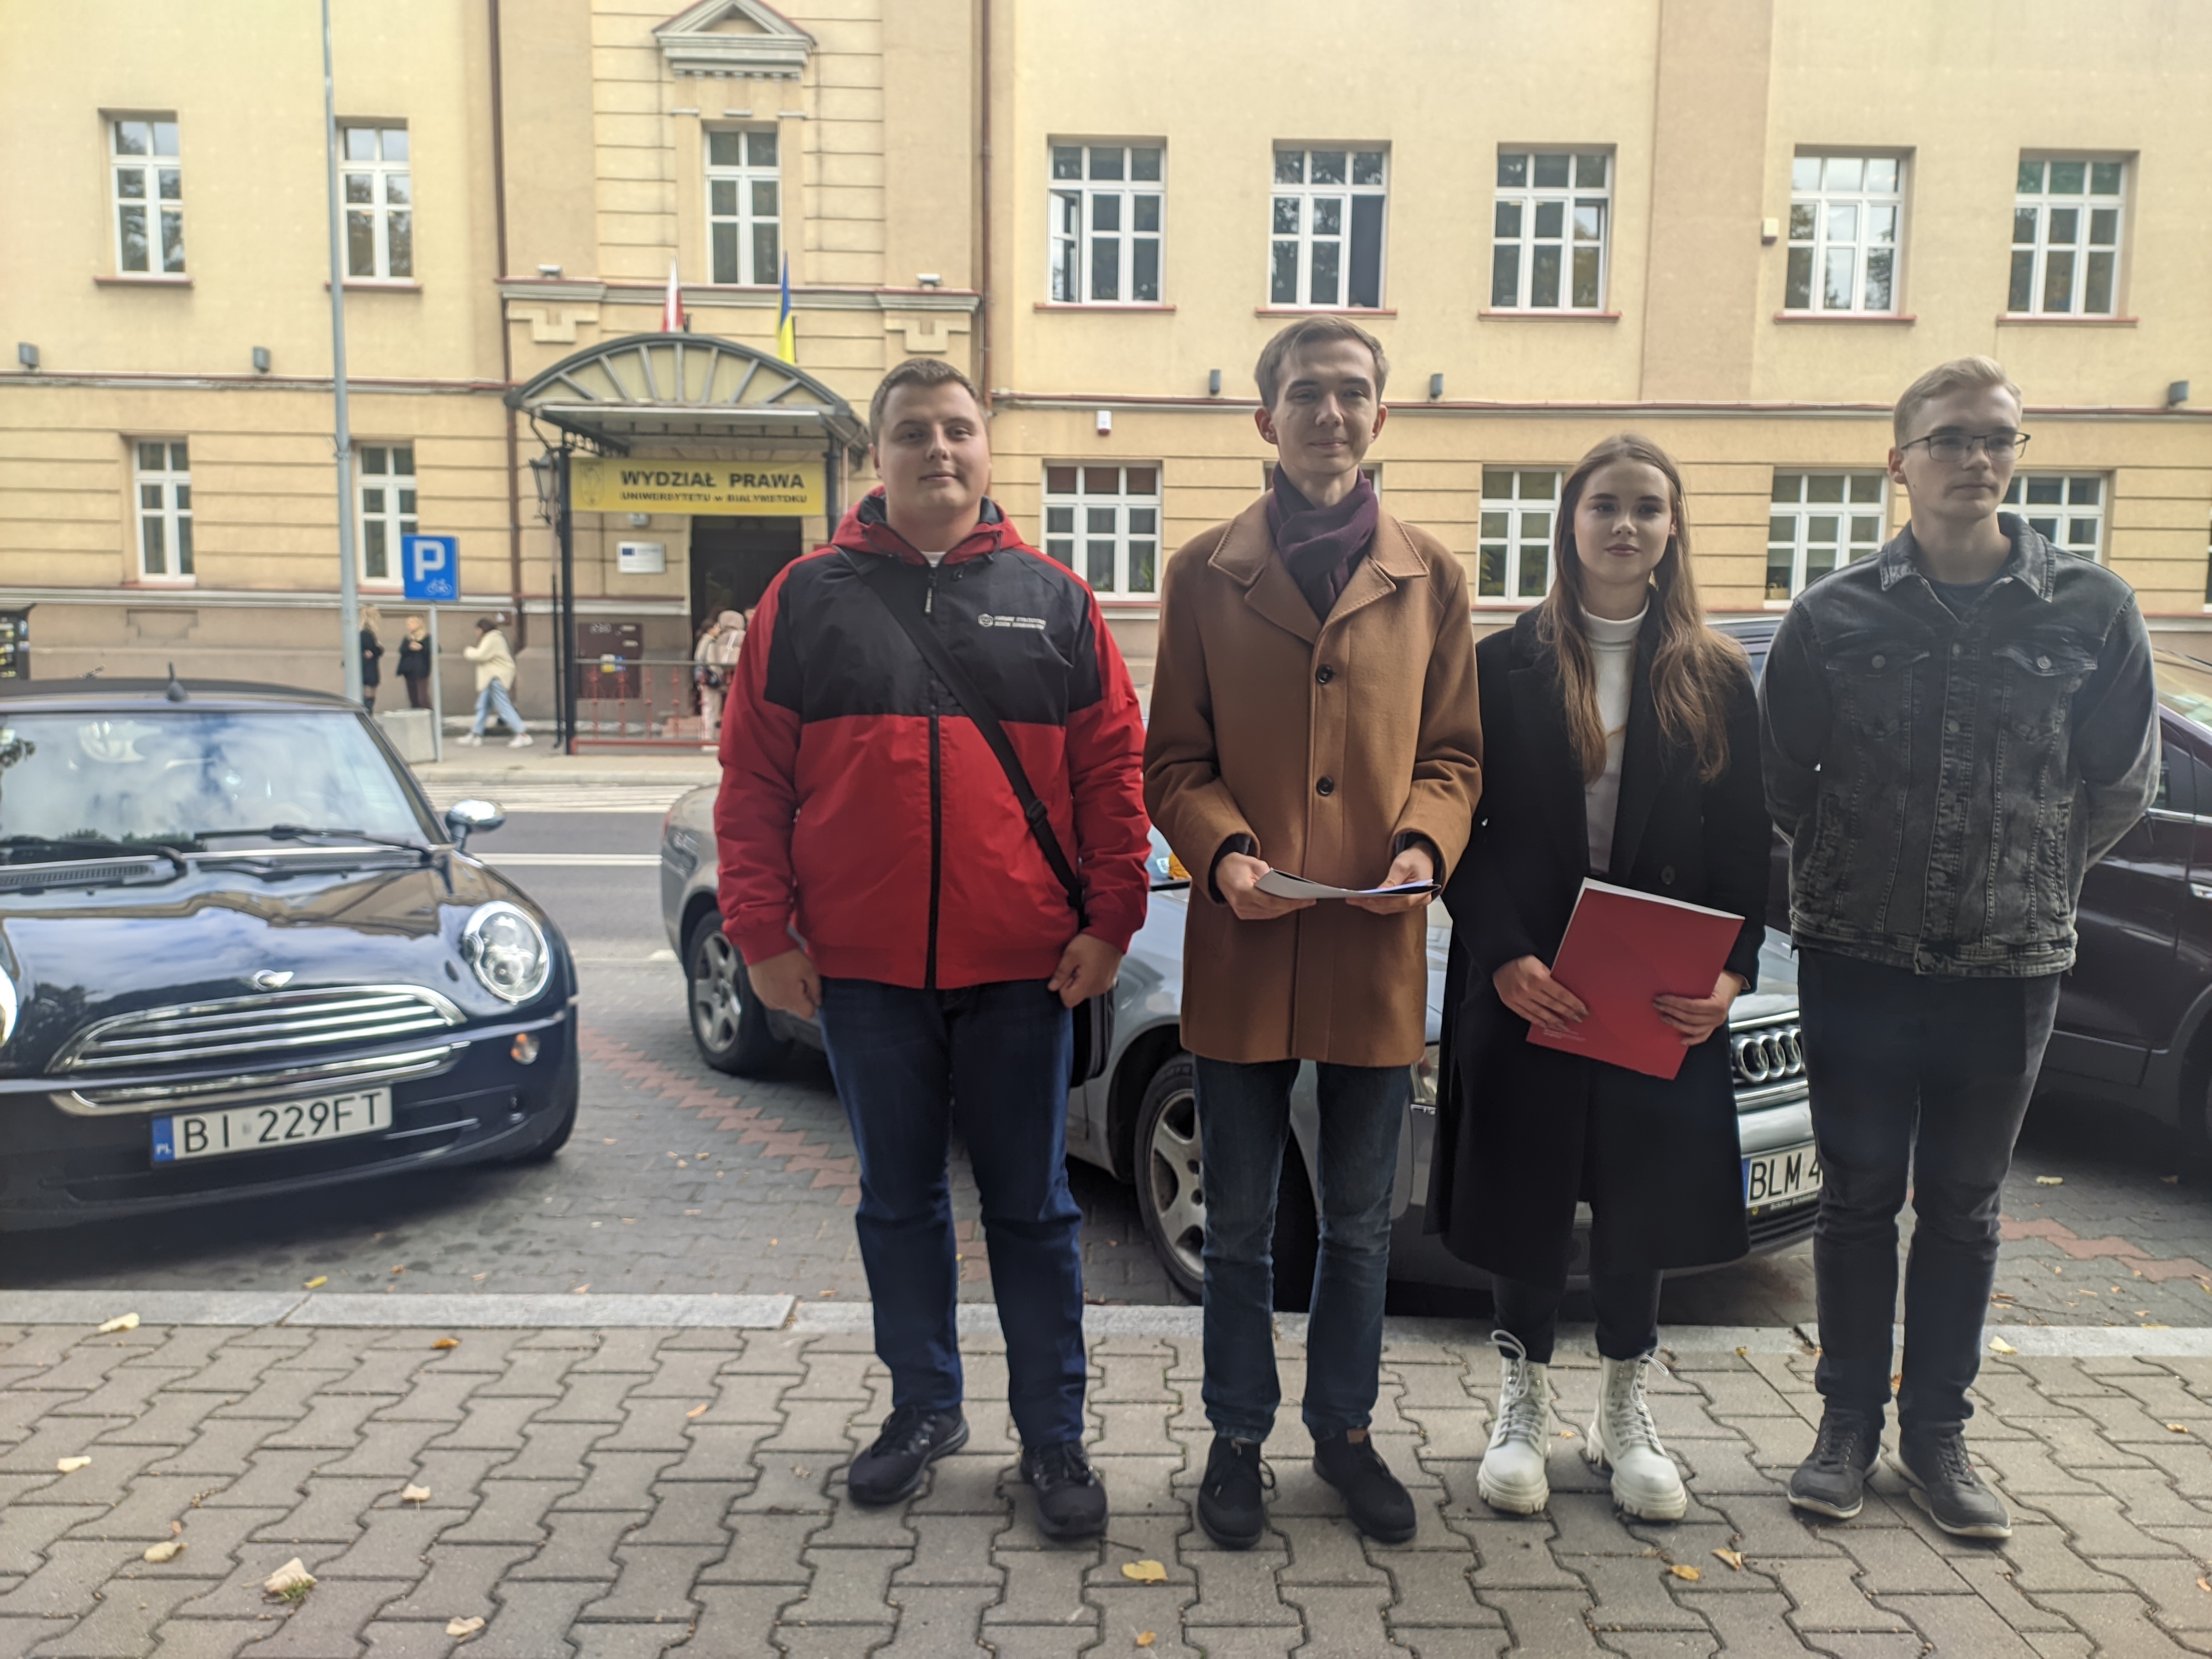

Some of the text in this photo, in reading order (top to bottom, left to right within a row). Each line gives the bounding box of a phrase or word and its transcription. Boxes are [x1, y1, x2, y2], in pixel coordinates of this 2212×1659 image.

[621, 471, 806, 488] WYDZIAŁ PRAWA
[414, 540, 446, 582] P
[184, 1091, 382, 1154] BI 229FT
[156, 1143, 171, 1155] PL
[1750, 1152, 1802, 1201] BLM
